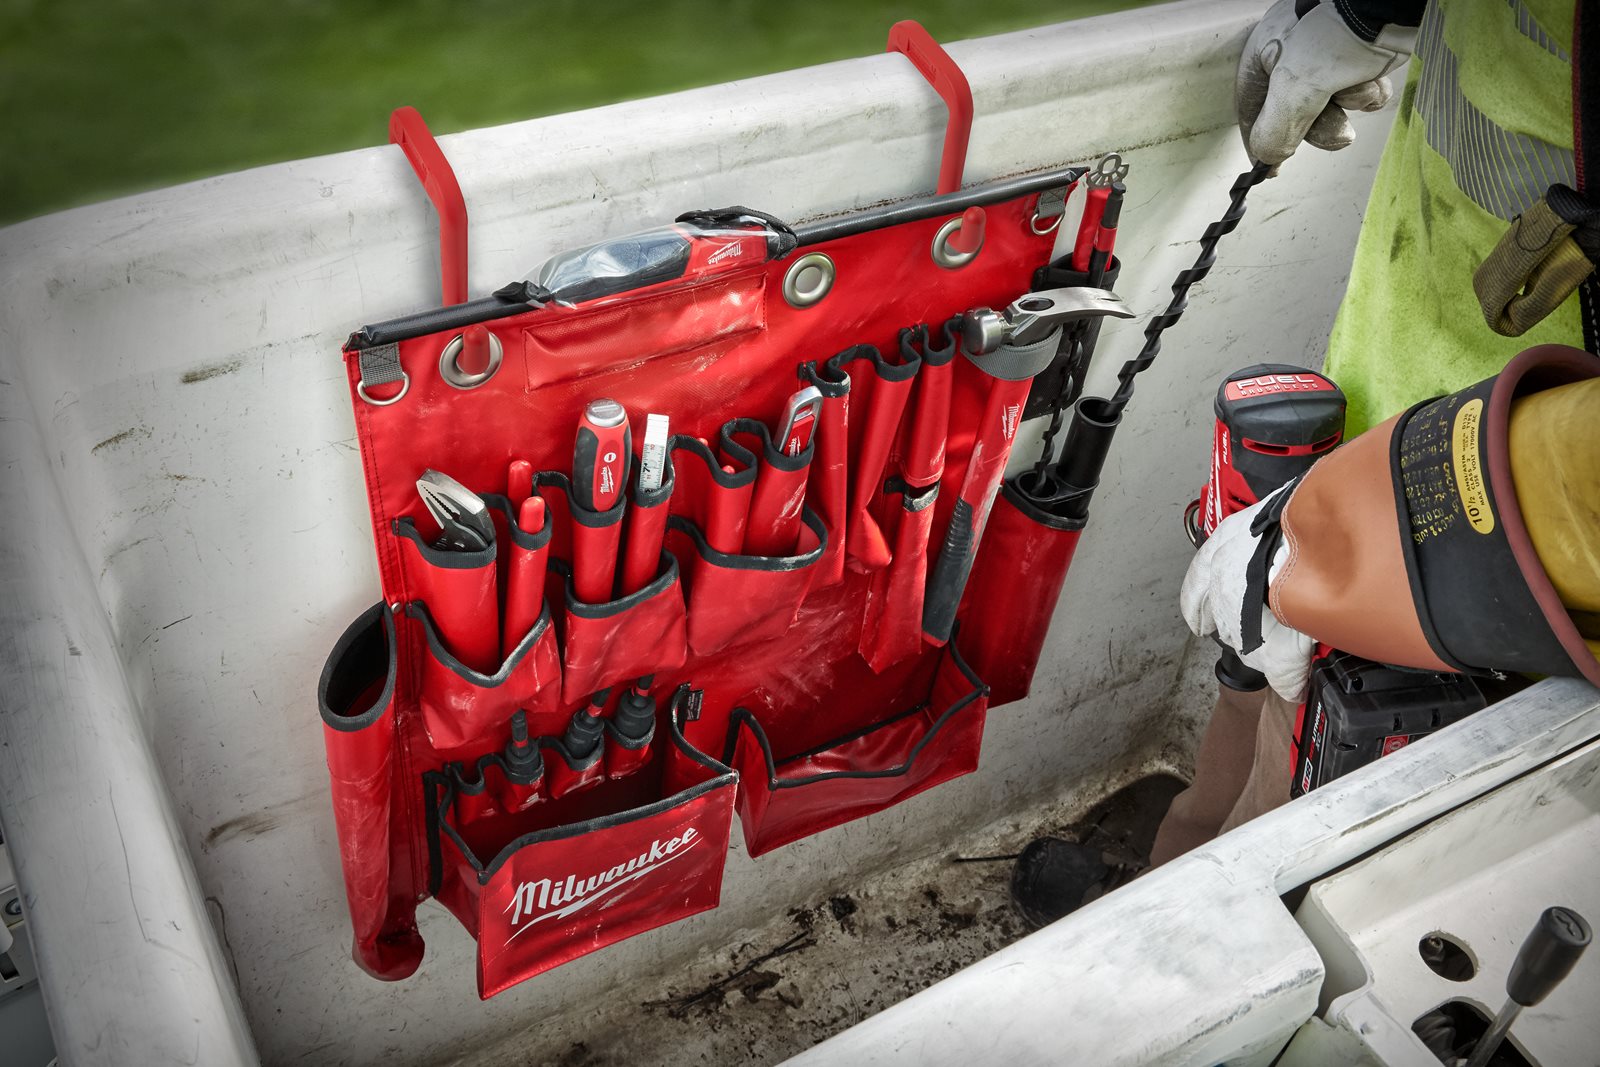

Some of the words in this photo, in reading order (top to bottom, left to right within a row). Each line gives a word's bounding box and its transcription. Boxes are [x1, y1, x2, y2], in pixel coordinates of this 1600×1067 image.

[708, 241, 743, 265] Milwaukee
[1237, 374, 1315, 389] FUEL
[1241, 383, 1319, 396] BRUSHLESS
[1008, 403, 1020, 440] Milwaukee
[1477, 490, 1485, 506] MAX
[503, 827, 699, 925] Milwaukee
